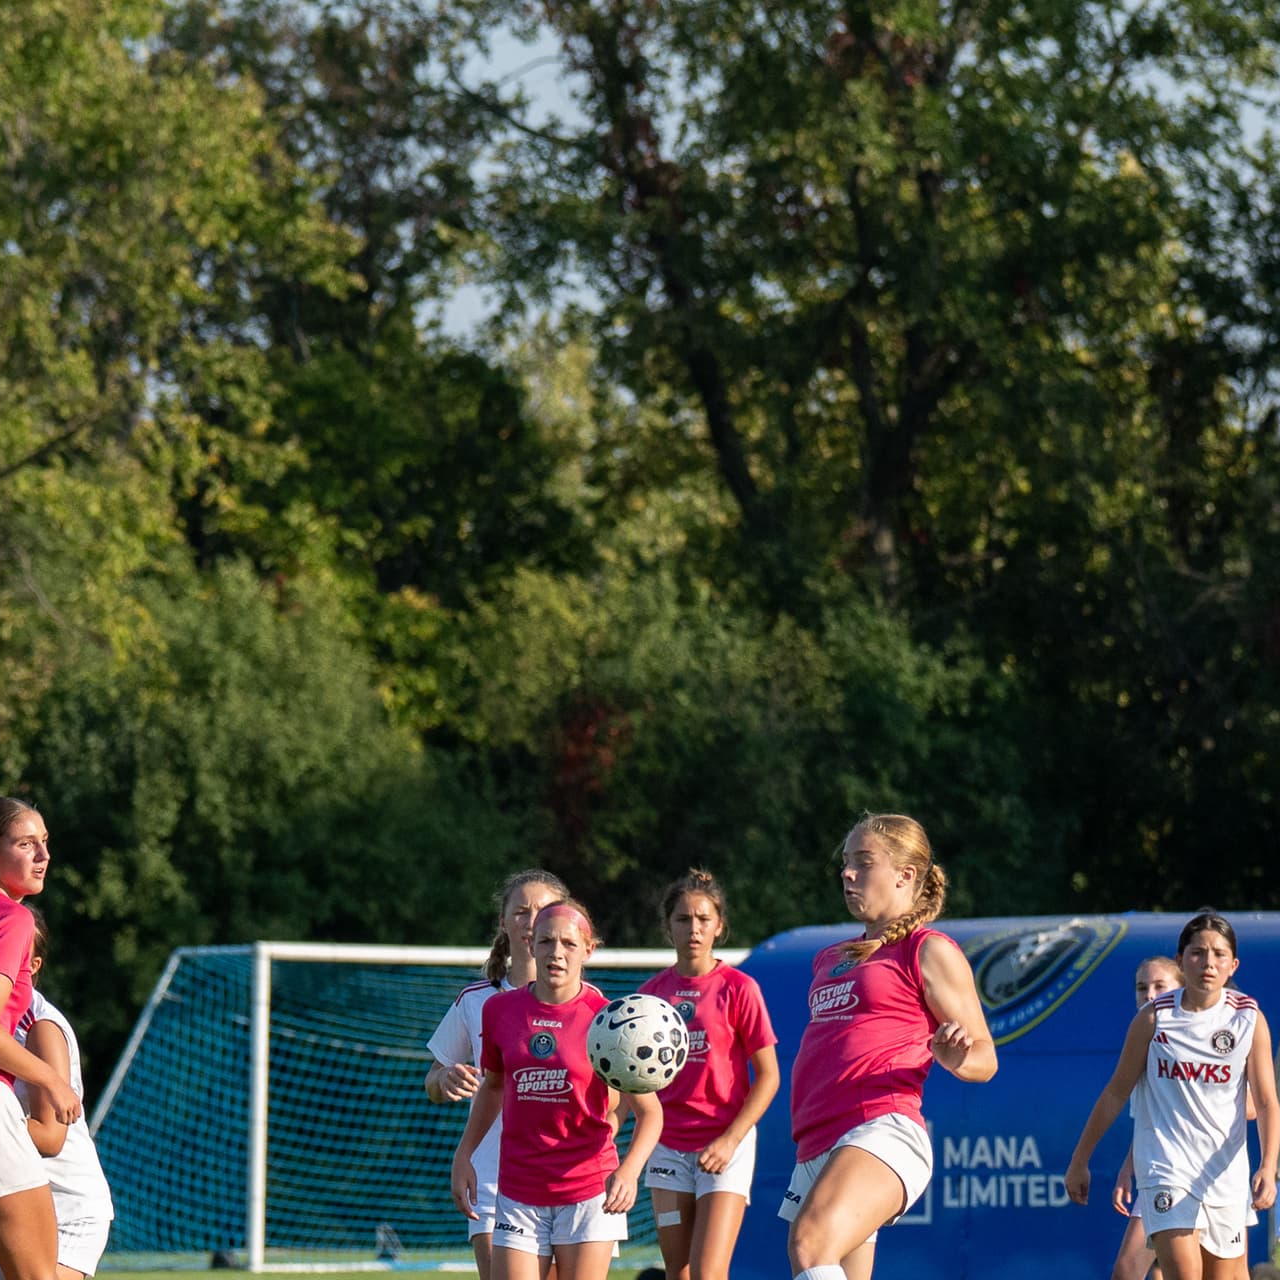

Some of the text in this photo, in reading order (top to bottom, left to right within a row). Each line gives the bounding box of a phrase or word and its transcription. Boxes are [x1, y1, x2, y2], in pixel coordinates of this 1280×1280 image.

[812, 981, 856, 1006] ACTION
[532, 1019, 562, 1028] LEGEA
[518, 1069, 567, 1082] ACTION
[1157, 1058, 1231, 1083] HAWKS
[517, 1079, 565, 1093] SPORTS
[943, 1136, 1042, 1169] MANA
[943, 1174, 1071, 1208] LIMITED
[495, 1221, 524, 1235] LEGEA
